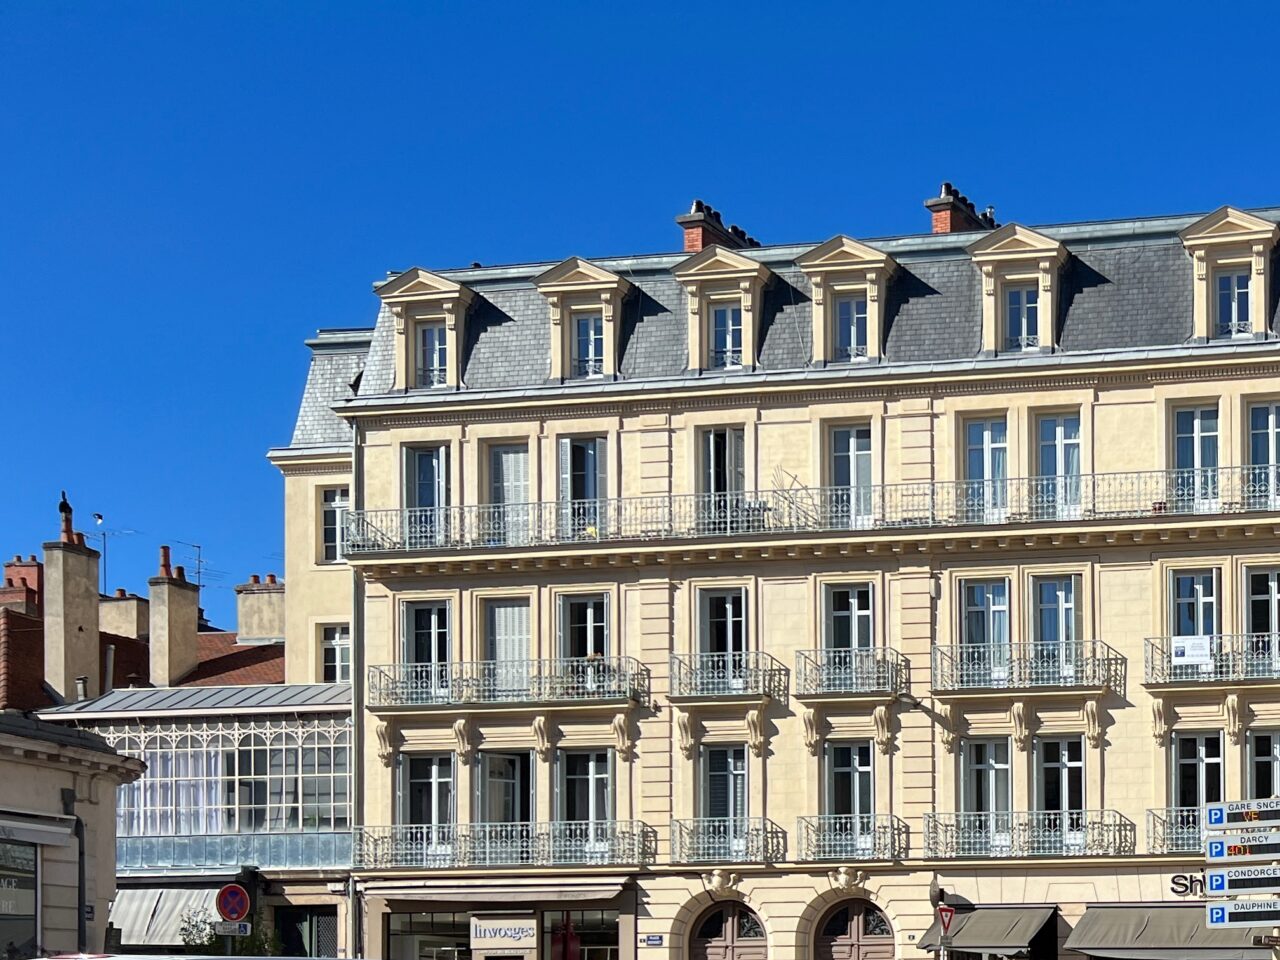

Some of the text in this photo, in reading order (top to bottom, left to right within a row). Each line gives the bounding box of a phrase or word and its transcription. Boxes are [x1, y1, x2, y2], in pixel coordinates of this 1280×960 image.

[1228, 801, 1280, 812] GARE SNCF
[1211, 809, 1221, 823] P
[1240, 835, 1269, 844] DARCY
[1212, 843, 1222, 857] P
[1212, 876, 1222, 890] P
[1234, 901, 1279, 911] DAUPHINE
[1213, 909, 1223, 922] P
[474, 923, 535, 941] linvosges
